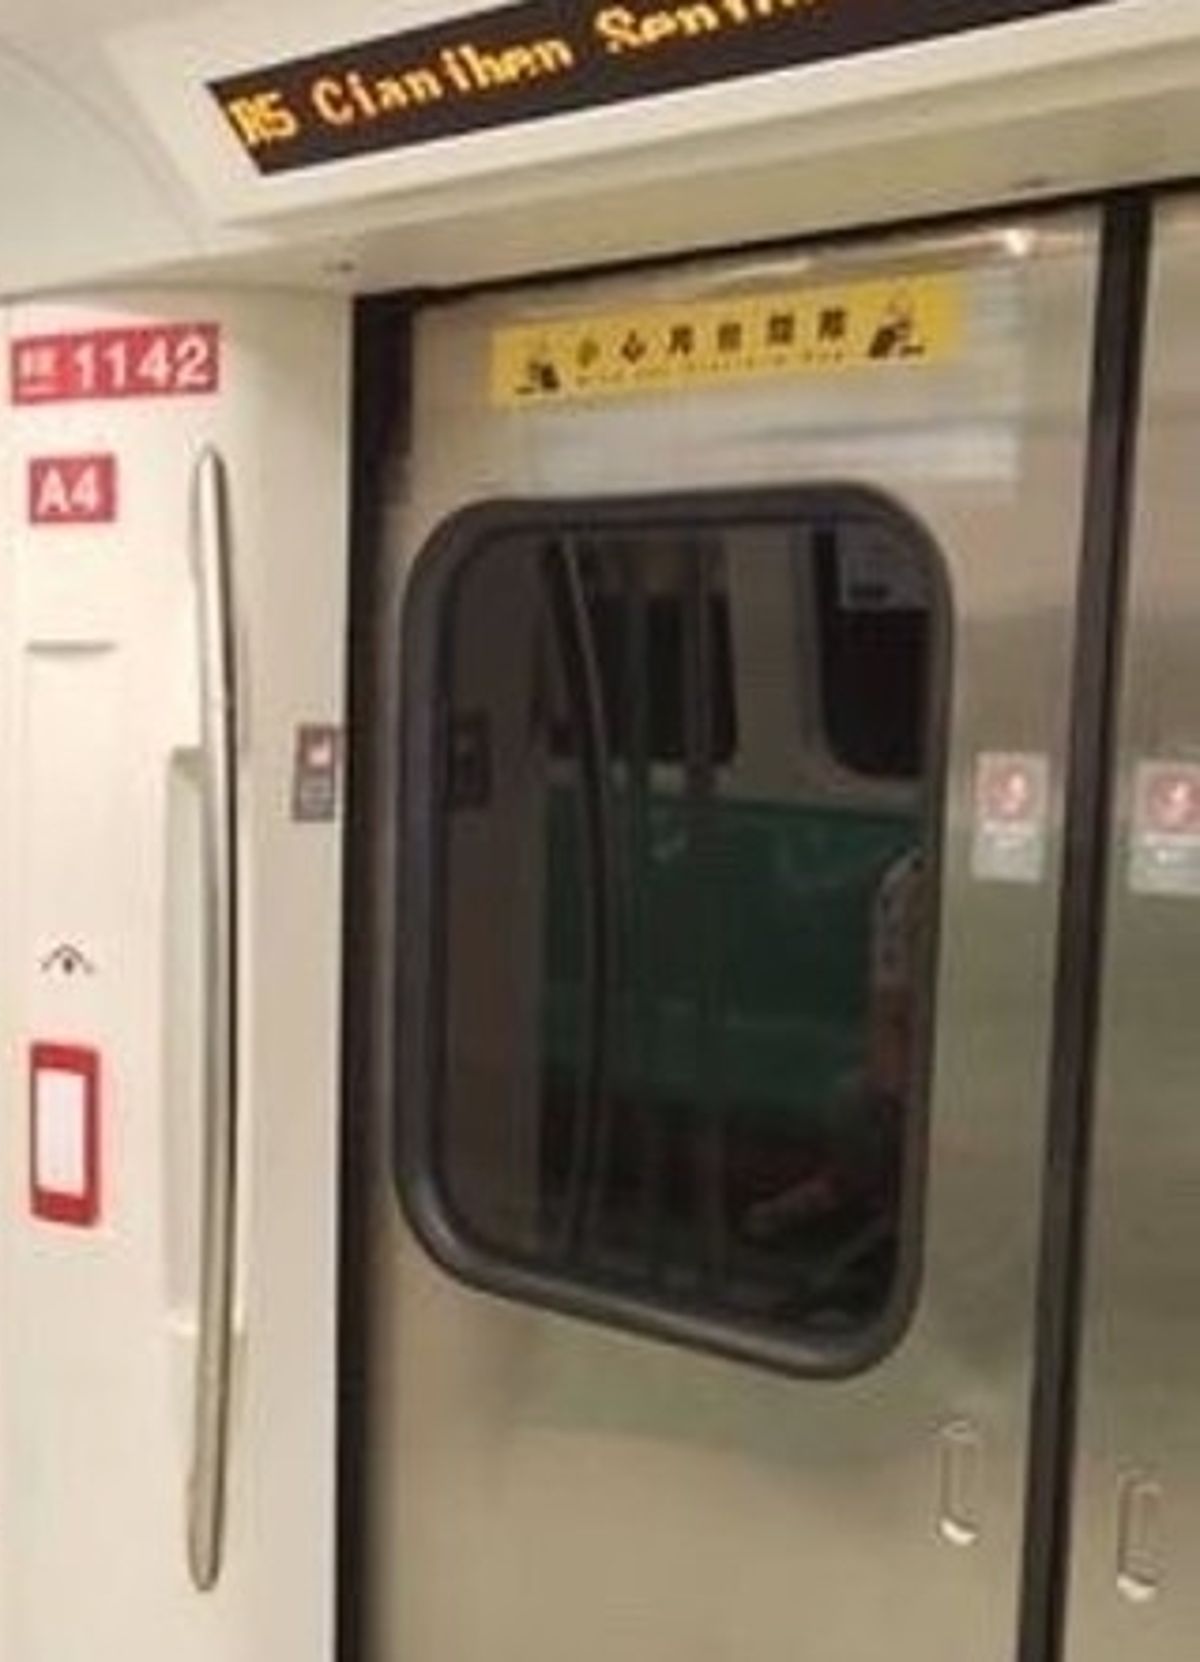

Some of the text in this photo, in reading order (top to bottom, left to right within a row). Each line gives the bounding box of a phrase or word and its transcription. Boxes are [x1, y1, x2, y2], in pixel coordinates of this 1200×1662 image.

[594, 0, 808, 53] Sen
[73, 334, 210, 390] 1142
[36, 464, 99, 515] A4
